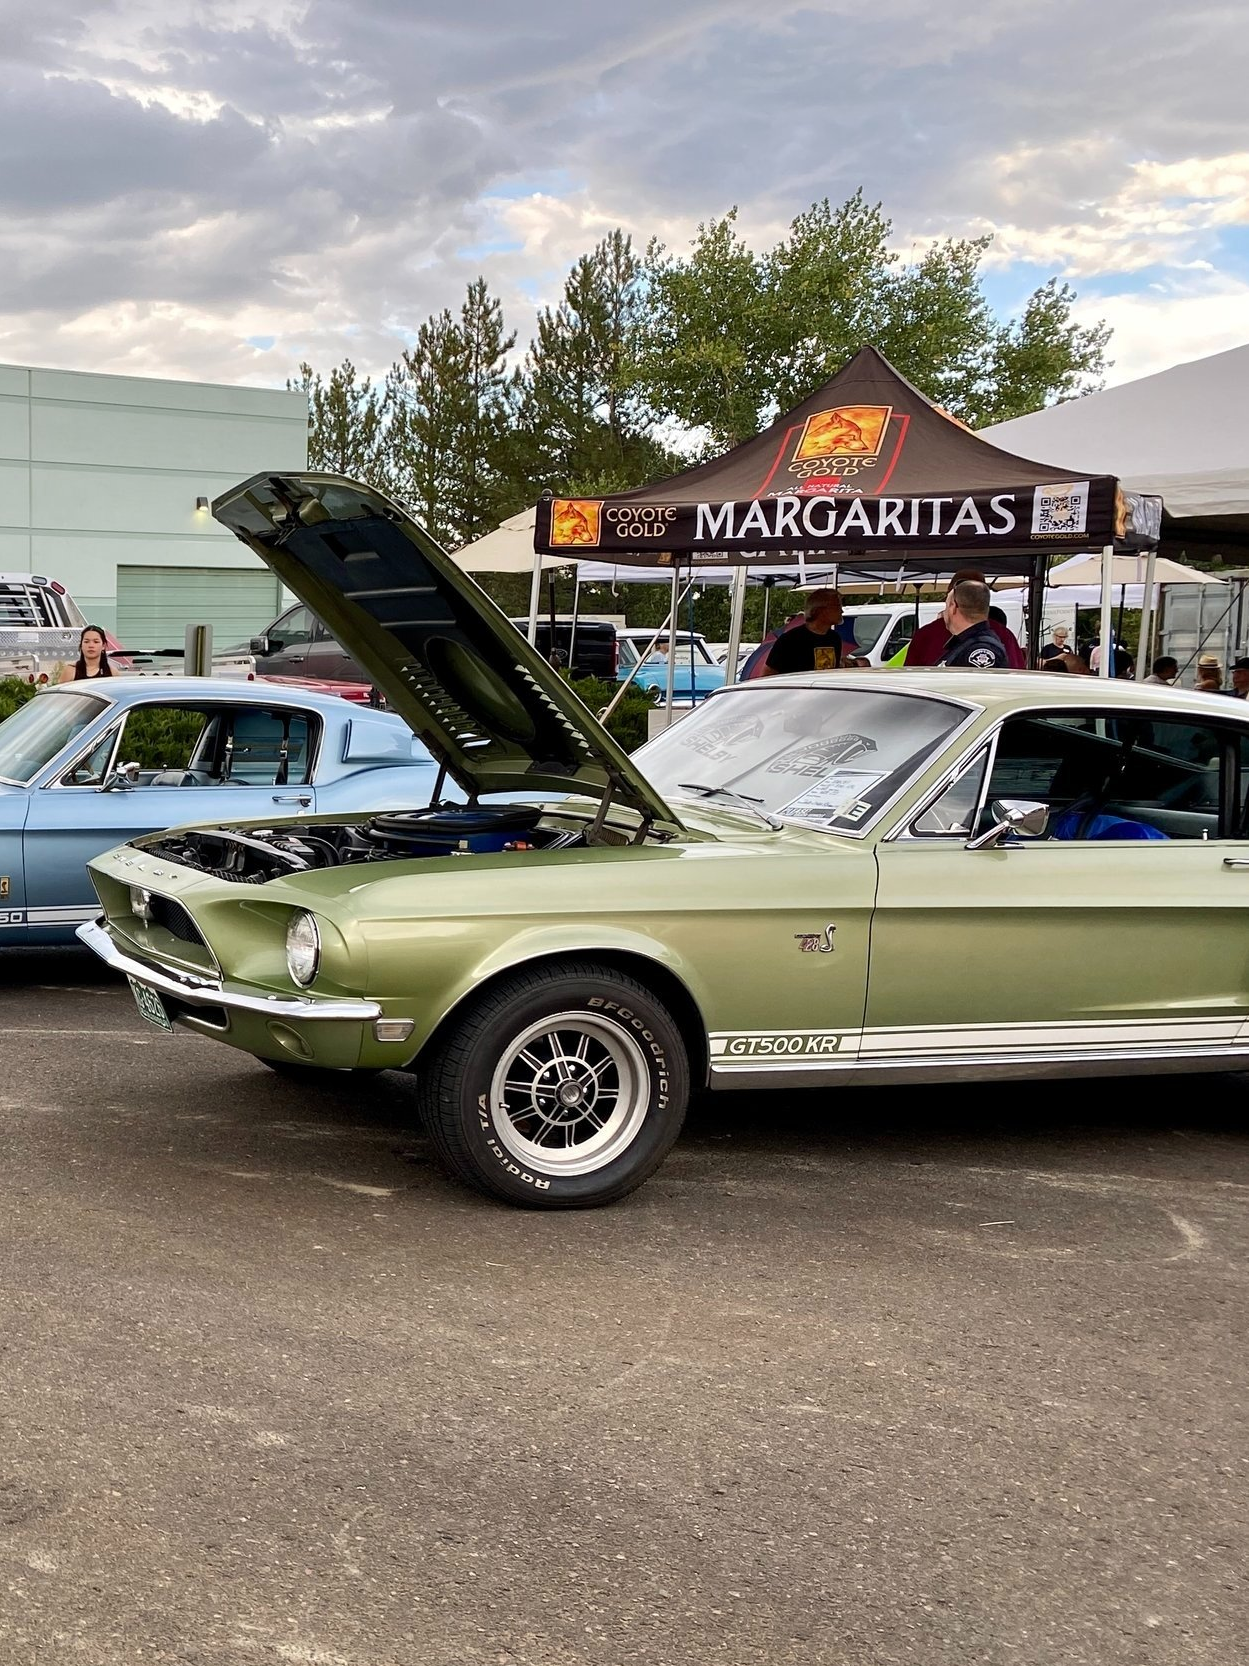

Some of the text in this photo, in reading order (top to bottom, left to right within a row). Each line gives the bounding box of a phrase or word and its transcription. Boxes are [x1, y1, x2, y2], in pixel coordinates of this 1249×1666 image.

[787, 457, 878, 472] COYOTE
[796, 467, 860, 479] GOLD
[767, 487, 864, 498] MARGARITA
[606, 507, 677, 522] COYOTE
[693, 493, 1016, 541] MARGARITAS
[616, 522, 666, 538] GOLD
[1030, 533, 1090, 541] COYOTEGOLD.COM
[767, 763, 828, 778] SHEL
[729, 1035, 838, 1055] GT500 KR
[587, 997, 670, 1110] BFGoodrich
[478, 1093, 551, 1191] Radial T/A
